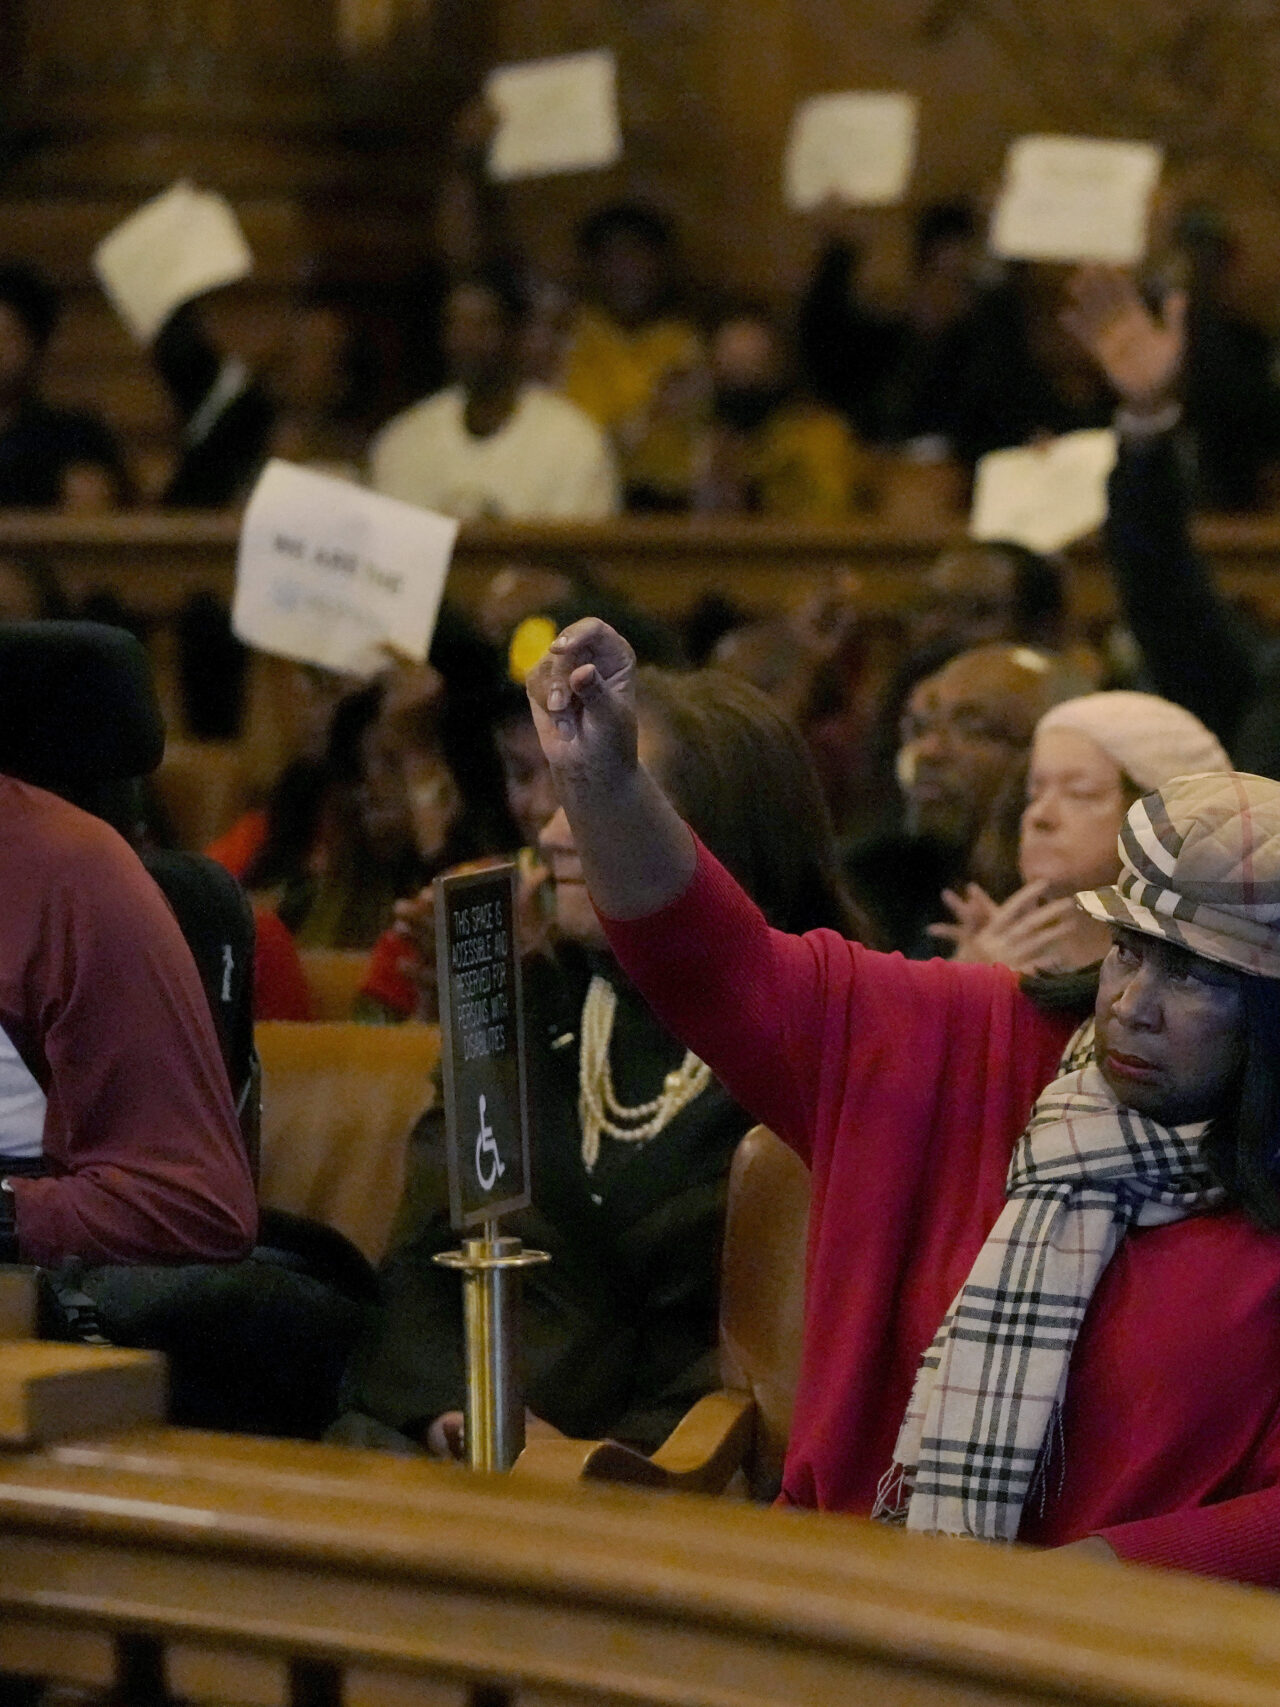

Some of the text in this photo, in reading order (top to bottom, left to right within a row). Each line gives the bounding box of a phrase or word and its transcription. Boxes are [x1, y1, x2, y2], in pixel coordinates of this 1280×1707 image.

[453, 908, 470, 936] THIS
[471, 902, 493, 933] SPACE
[452, 934, 492, 968] ACCESSIBLE
[456, 961, 506, 998] RESERVED FOR
[457, 998, 489, 1030] PERSONS
[463, 1024, 505, 1061] DISABILITIES
